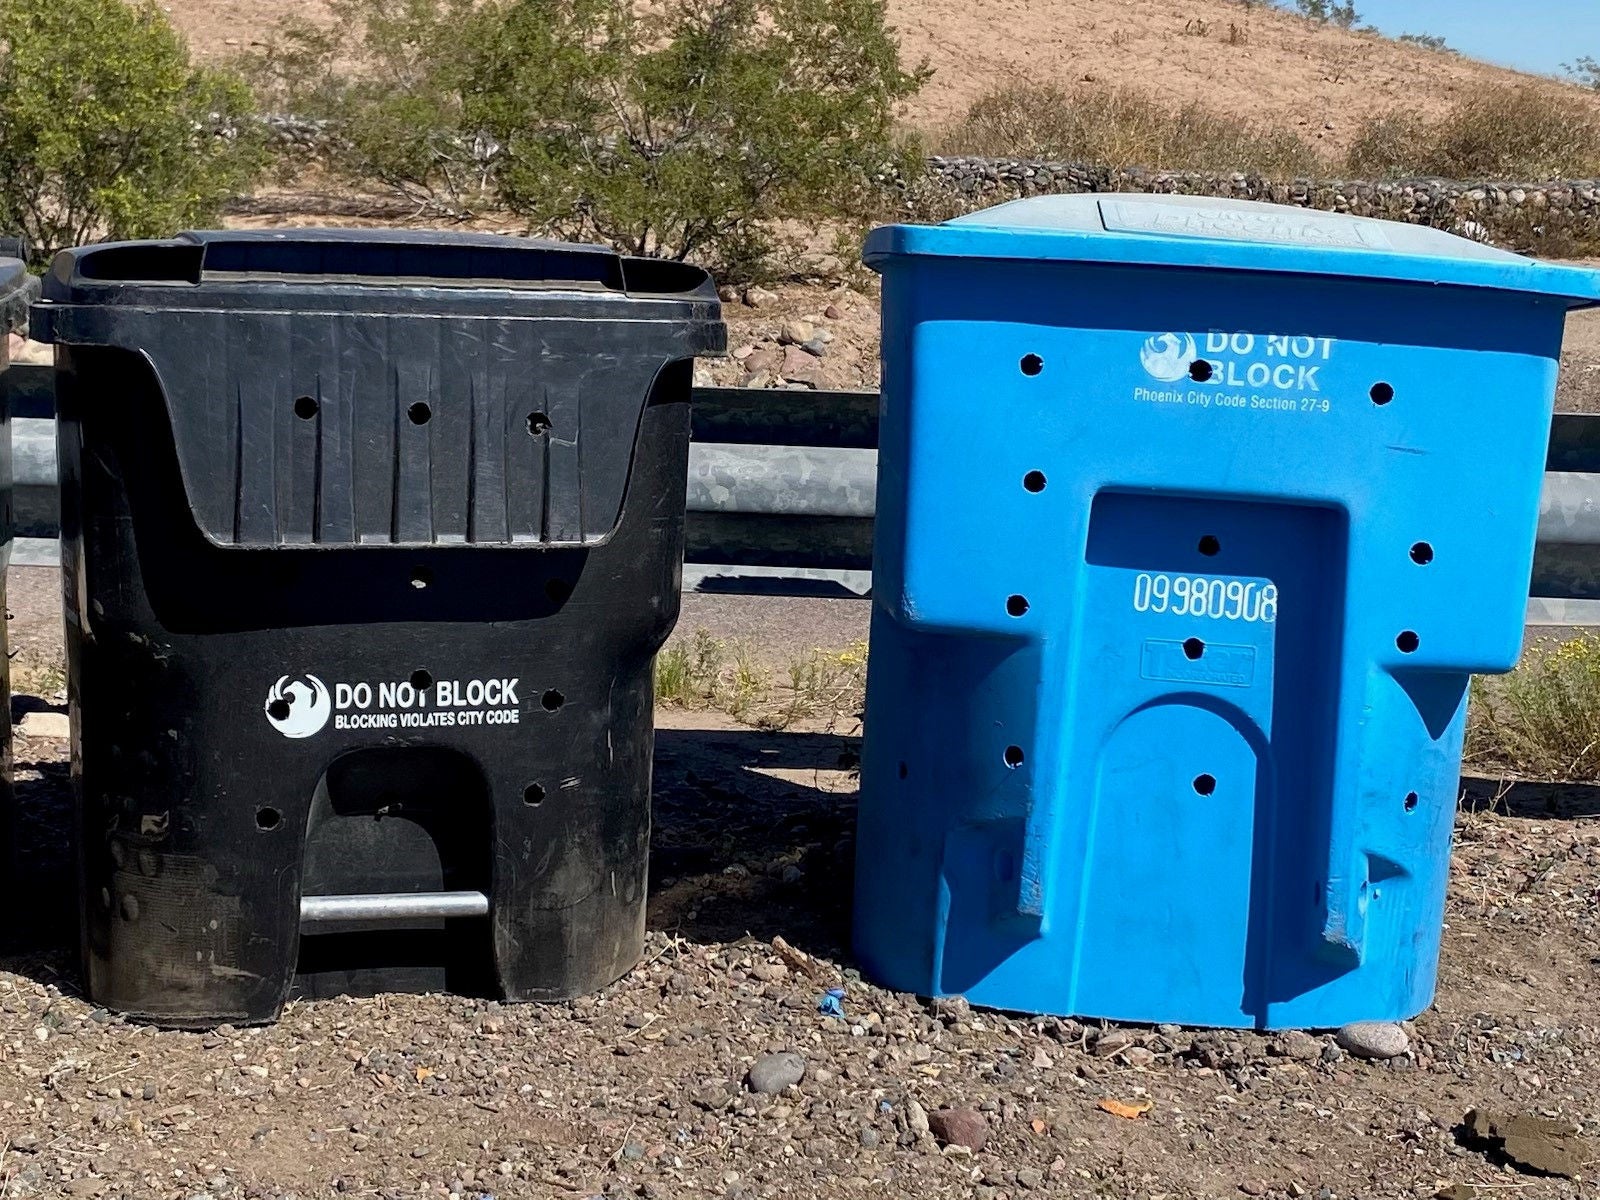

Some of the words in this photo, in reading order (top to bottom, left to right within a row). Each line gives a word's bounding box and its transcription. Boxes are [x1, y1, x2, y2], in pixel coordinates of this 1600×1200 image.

[1206, 329, 1255, 355] DO
[1267, 332, 1338, 360] NOT
[1206, 359, 1321, 391] BLOCK
[1134, 387, 1183, 404] Phoenix
[1187, 391, 1211, 408] City
[1215, 393, 1247, 408] Code
[1250, 395, 1297, 411] Section
[1300, 398, 1330, 413] 27-9
[335, 682, 373, 709] DO
[436, 678, 519, 707] BLOCK
[335, 713, 398, 729] BLOCKING
[399, 711, 456, 728] VIOLATES
[457, 710, 485, 726] CITY
[486, 708, 520, 725] CODE
